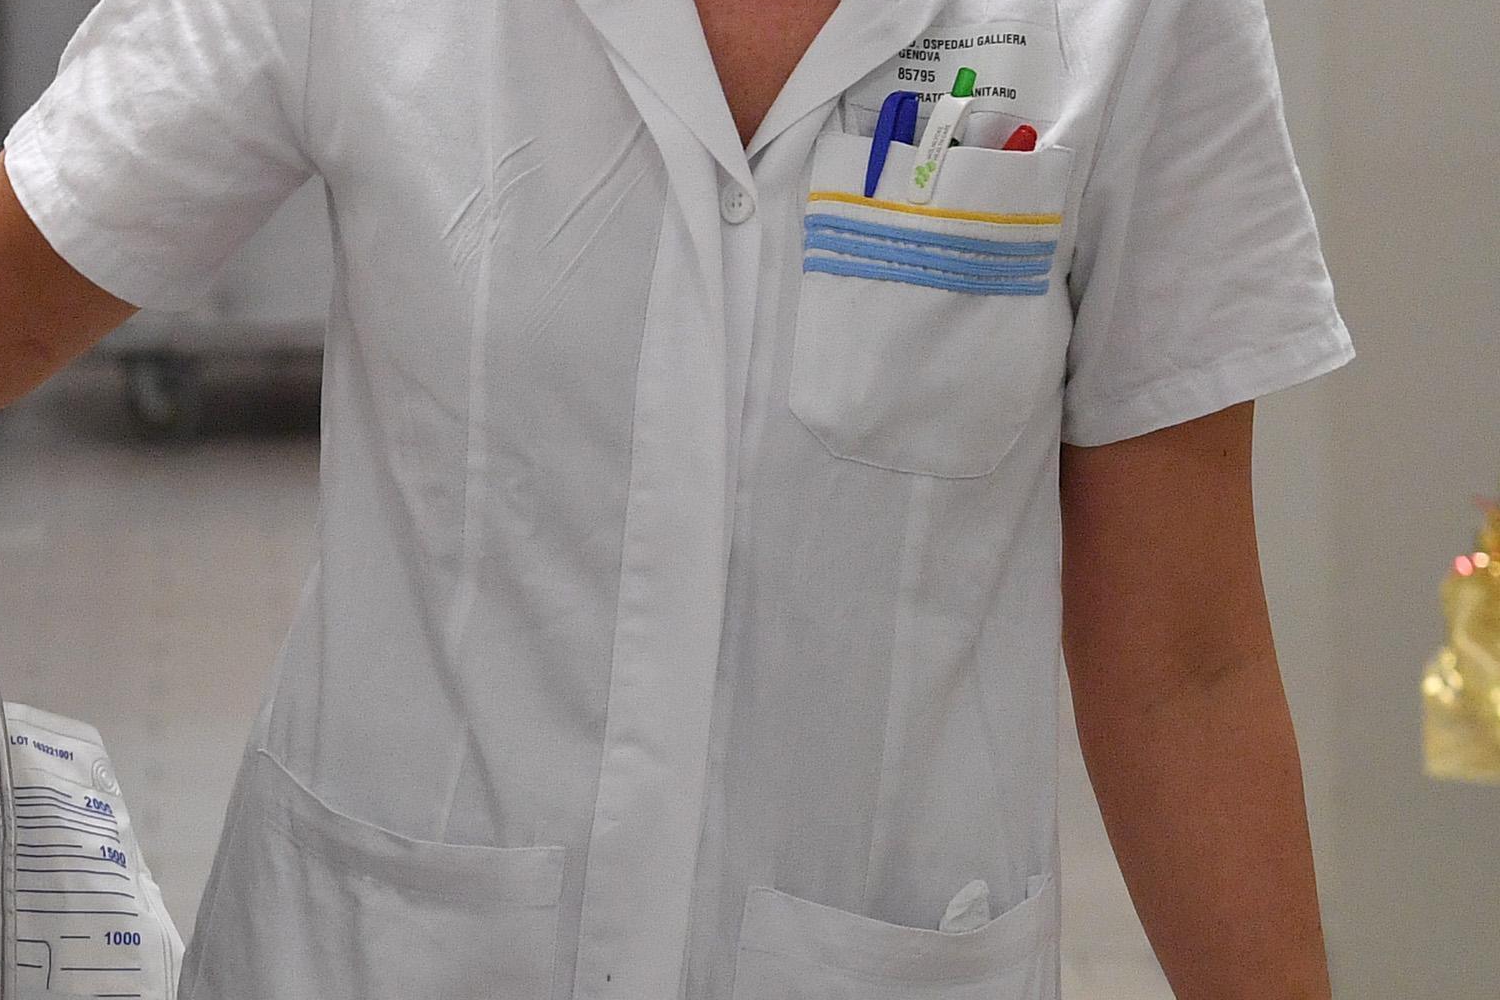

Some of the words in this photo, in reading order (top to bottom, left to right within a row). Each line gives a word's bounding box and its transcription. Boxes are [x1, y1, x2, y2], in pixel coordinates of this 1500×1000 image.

[923, 38, 974, 50] OSPEDALI
[977, 34, 1027, 46] GALLIERA
[899, 49, 941, 62] GENOVA
[898, 67, 936, 83] 85795
[10, 736, 29, 745] LOT
[84, 796, 113, 814] 2000
[100, 845, 126, 863] 1500
[104, 932, 141, 946] 1000
